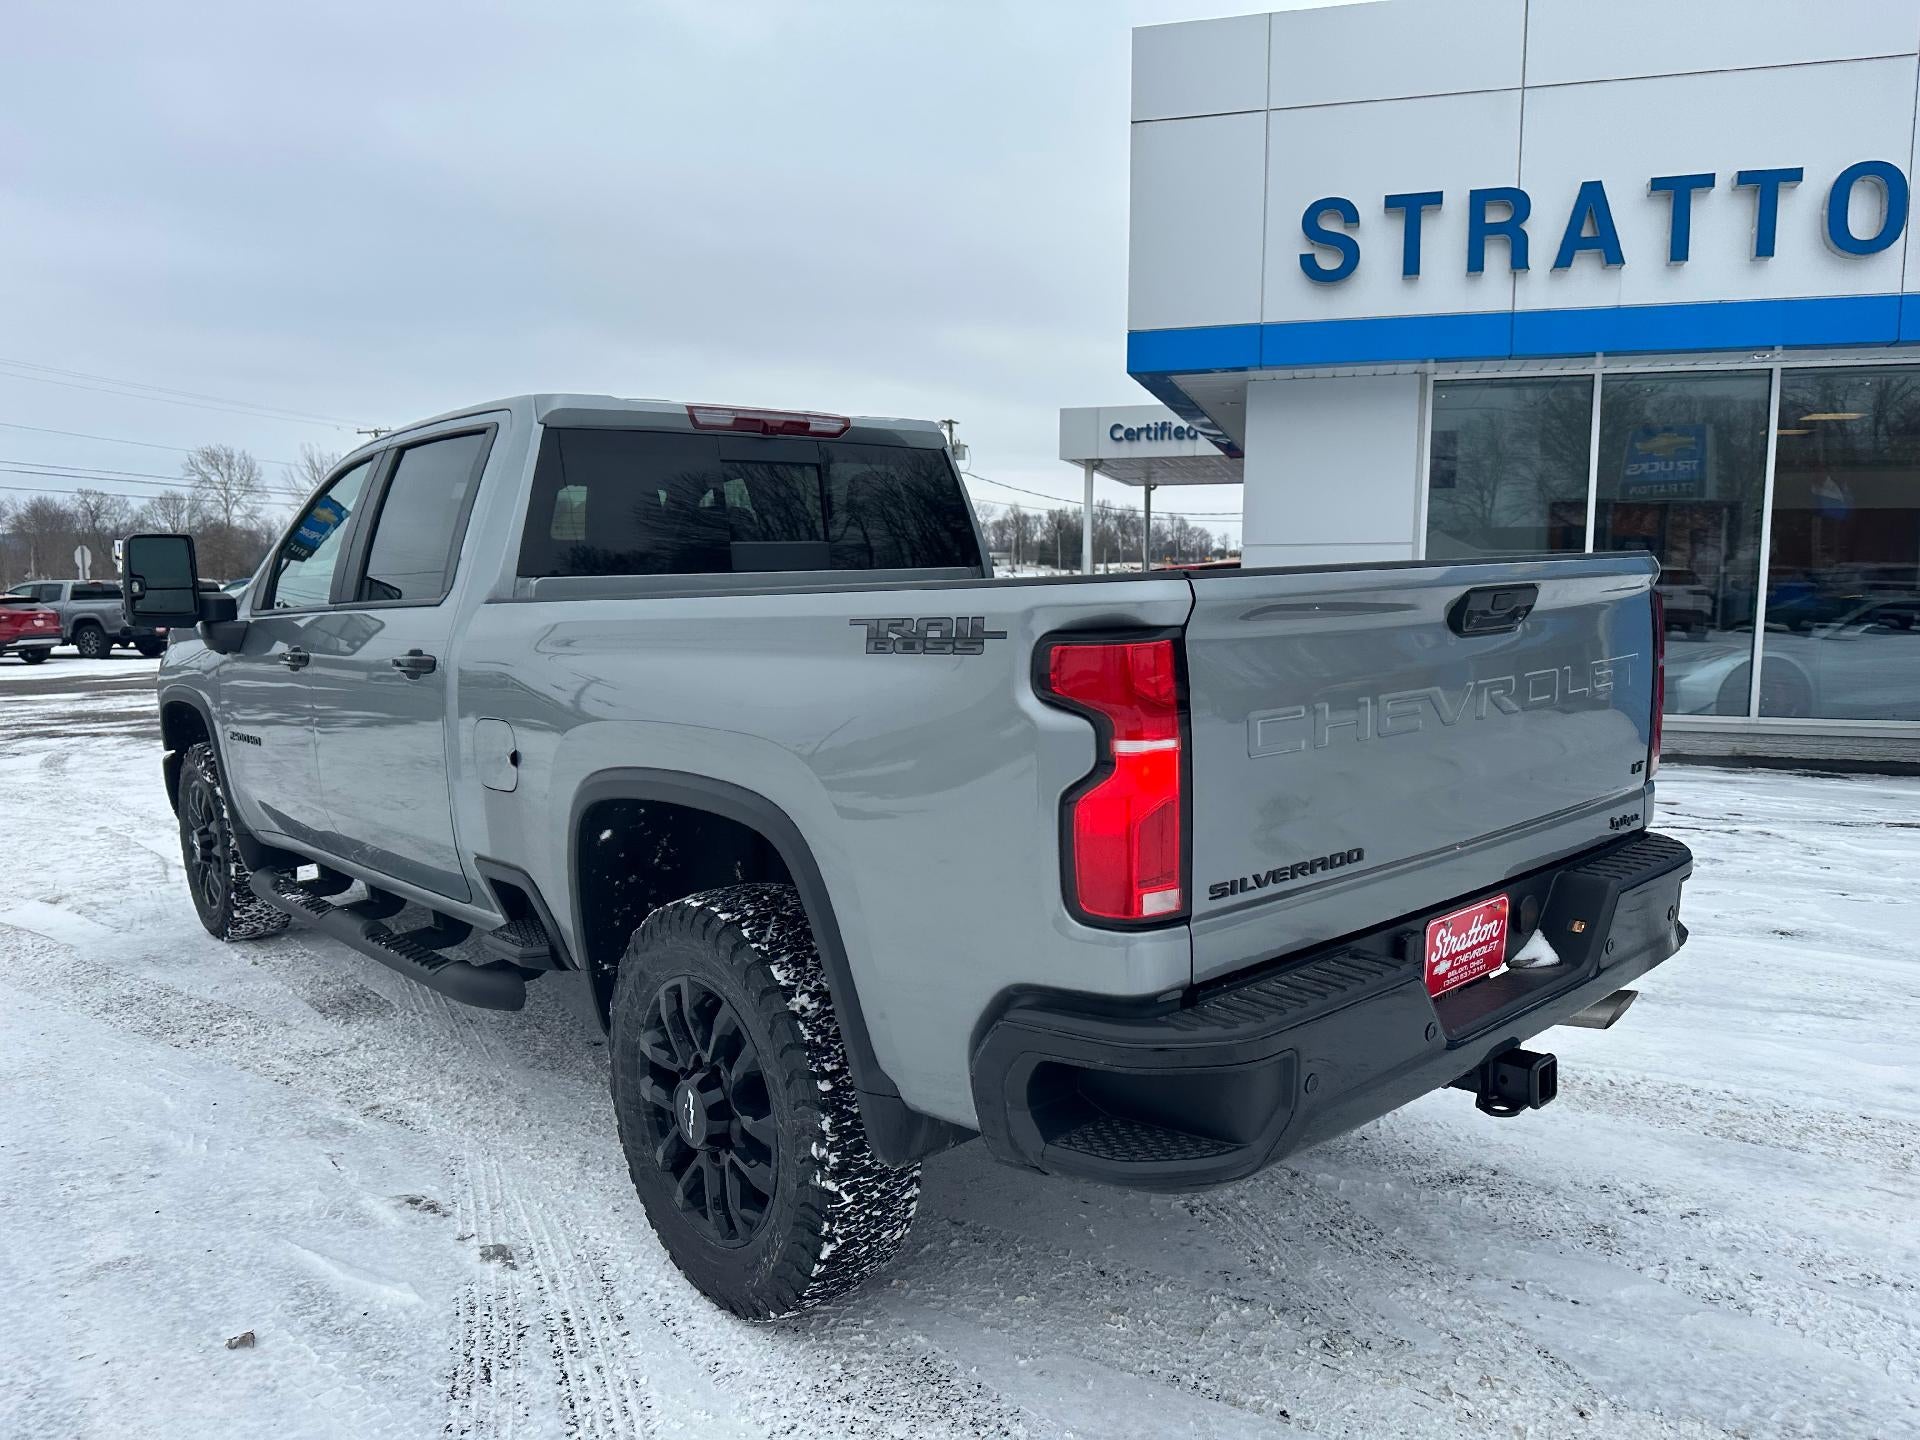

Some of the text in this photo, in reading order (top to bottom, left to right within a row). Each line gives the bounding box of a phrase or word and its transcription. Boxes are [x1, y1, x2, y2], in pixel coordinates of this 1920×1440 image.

[1298, 160, 1910, 284] STRATTO
[849, 616, 1008, 639] TRAIL
[866, 637, 985, 655] BOSS
[1247, 653, 1639, 758] CHEVROLET
[1208, 847, 1365, 900] SILVERADO
[1431, 913, 1503, 963] Stratton
[1453, 940, 1499, 967] CHEVROLET
